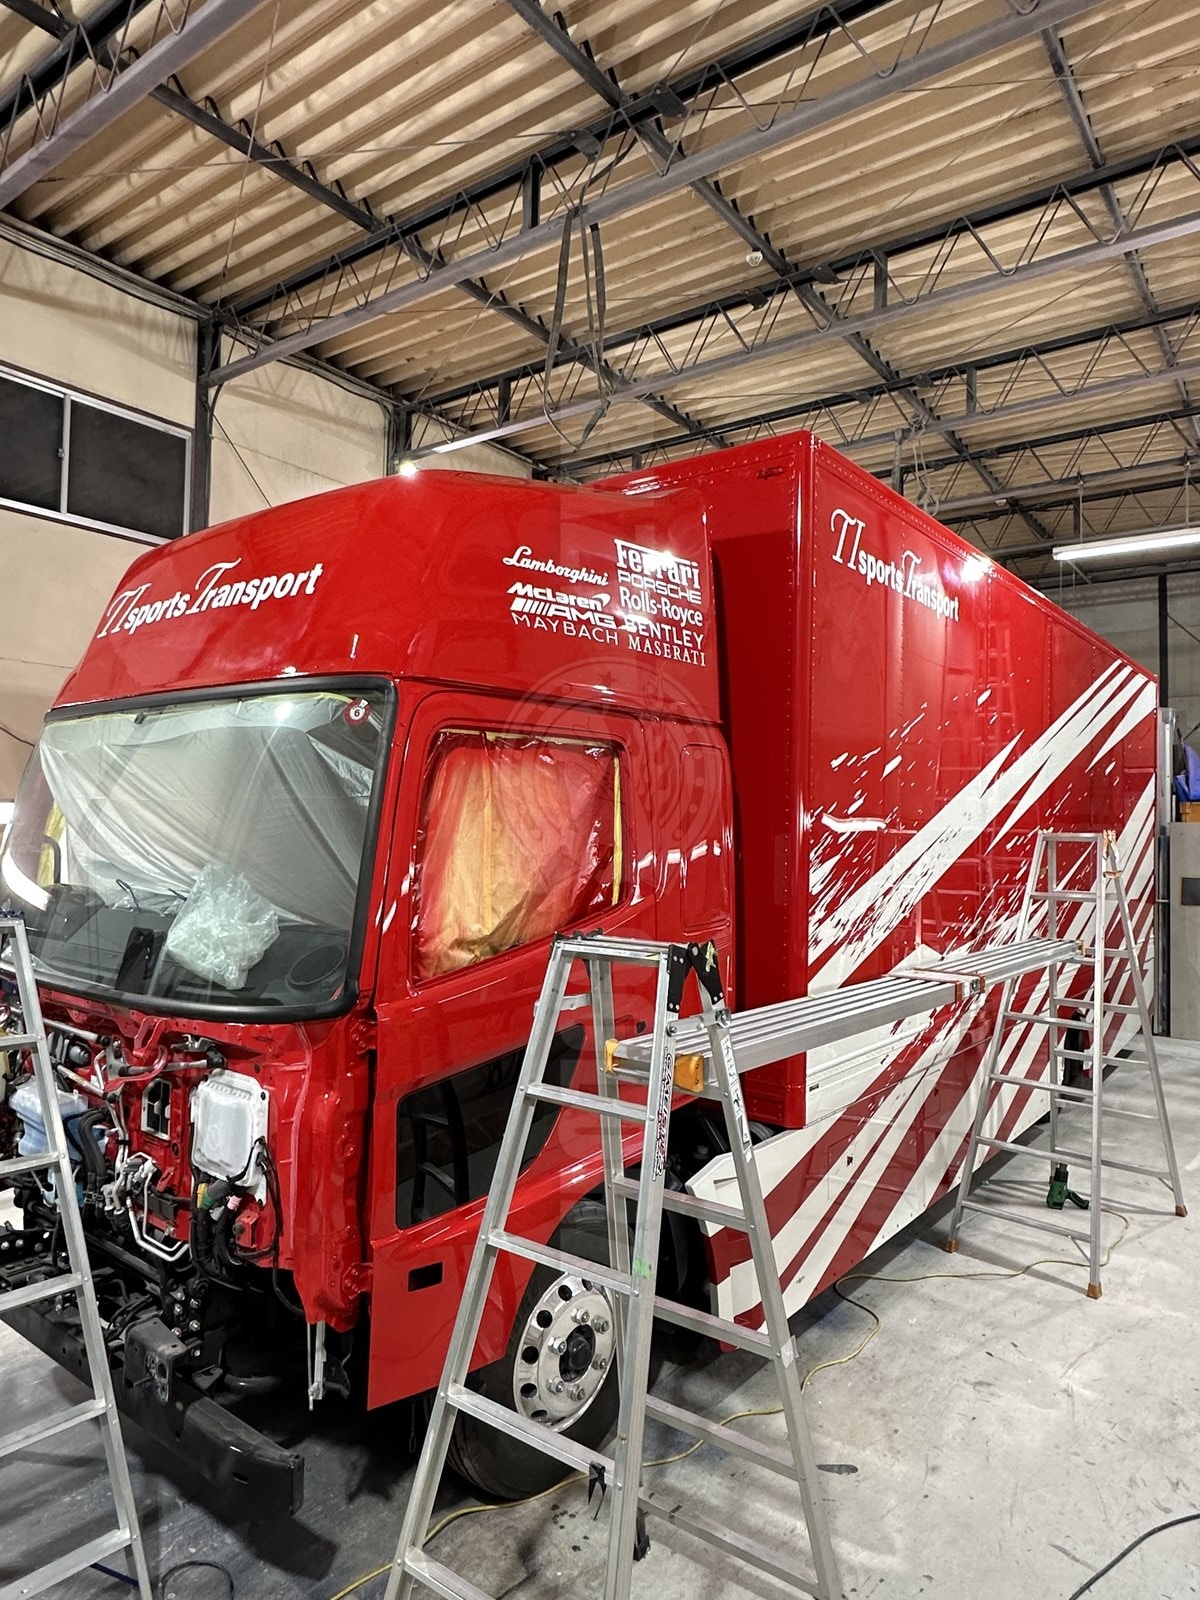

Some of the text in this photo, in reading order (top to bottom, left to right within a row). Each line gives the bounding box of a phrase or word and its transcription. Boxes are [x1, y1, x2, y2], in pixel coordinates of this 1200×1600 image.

[502, 546, 609, 587] Lamborghini
[613, 538, 701, 589] Ferrari
[185, 557, 323, 615] Transport
[506, 582, 604, 610] McLaren
[617, 569, 702, 605] PORSCHE
[902, 550, 959, 622] Transport
[550, 602, 617, 630] AMG
[619, 586, 703, 627] Rolls-Royce
[511, 612, 619, 646] MAYBACH
[622, 613, 704, 649] BENTLEY
[627, 634, 706, 667] MASERATI
